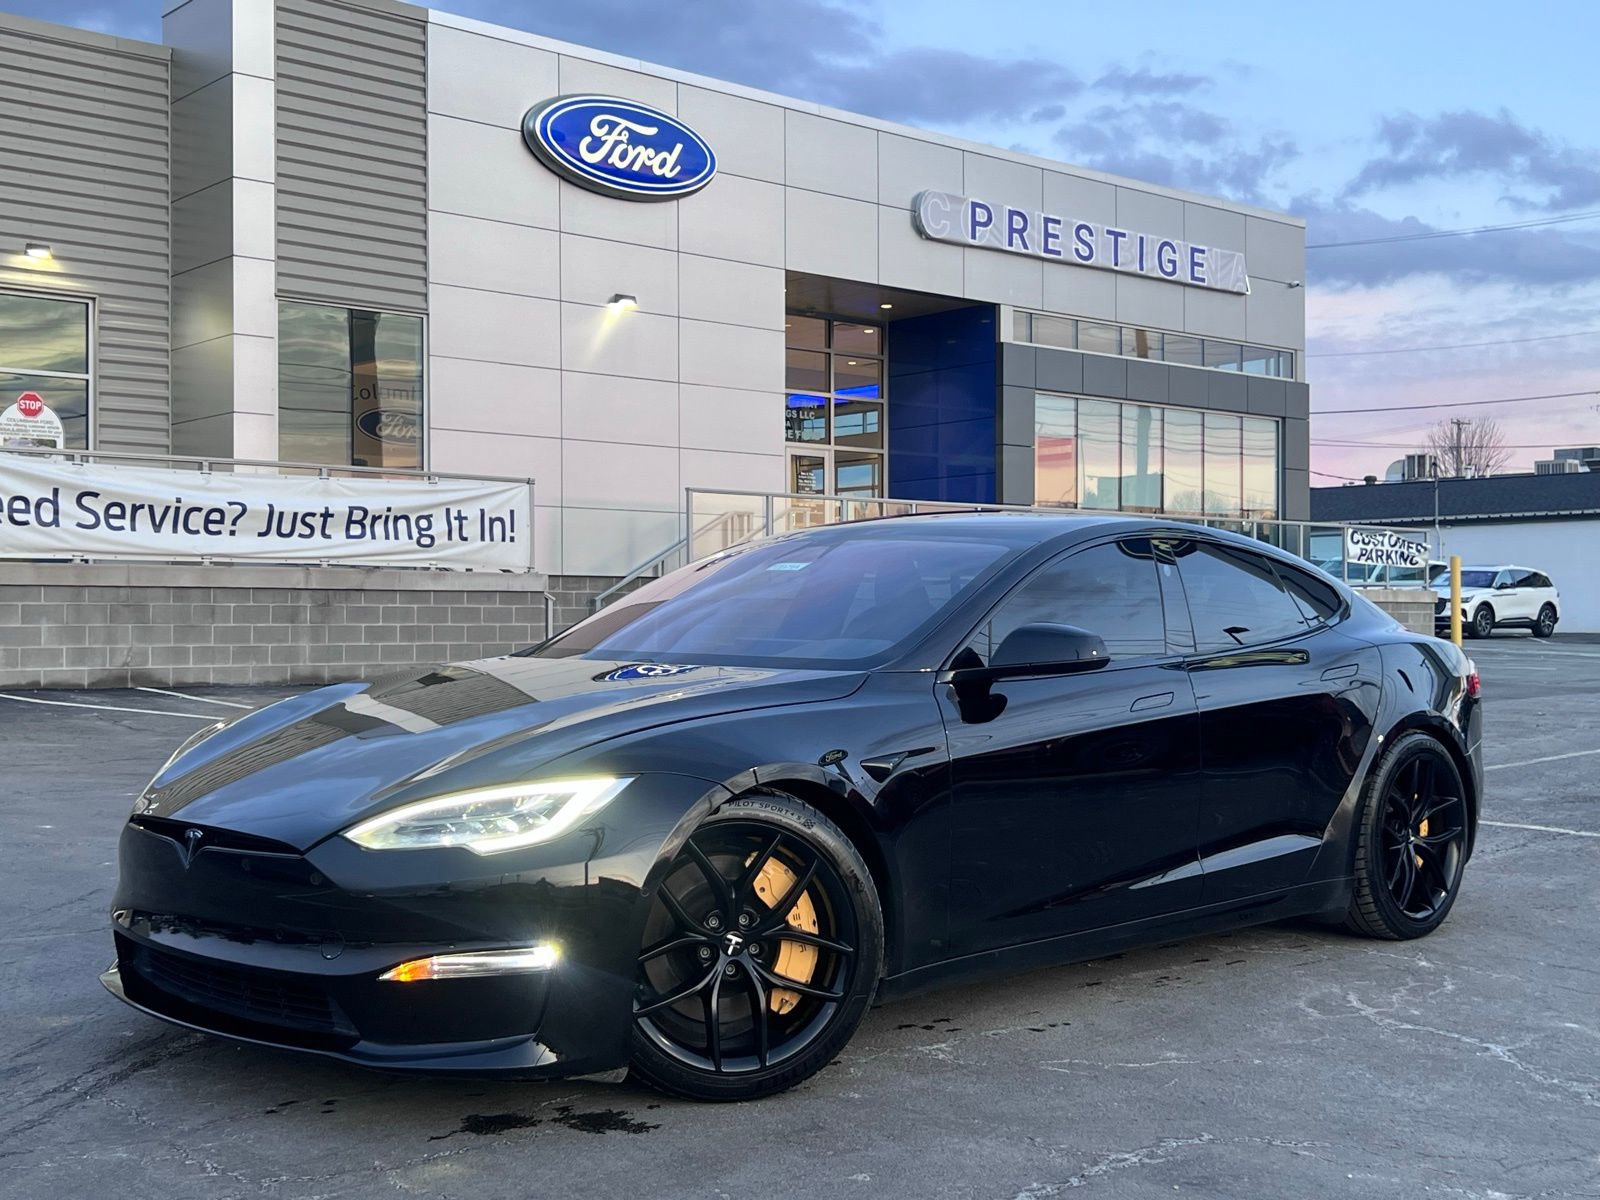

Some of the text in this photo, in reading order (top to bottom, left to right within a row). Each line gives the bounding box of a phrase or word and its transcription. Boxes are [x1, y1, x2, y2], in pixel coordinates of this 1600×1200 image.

[579, 114, 684, 178] Ford
[968, 200, 1208, 285] PRESTIGE
[19, 400, 42, 410] STOP
[799, 410, 816, 420] LLC
[0, 488, 516, 548] ed Service? Just Bring It In!
[728, 800, 755, 808] PILOT
[759, 802, 789, 816] SPORT
